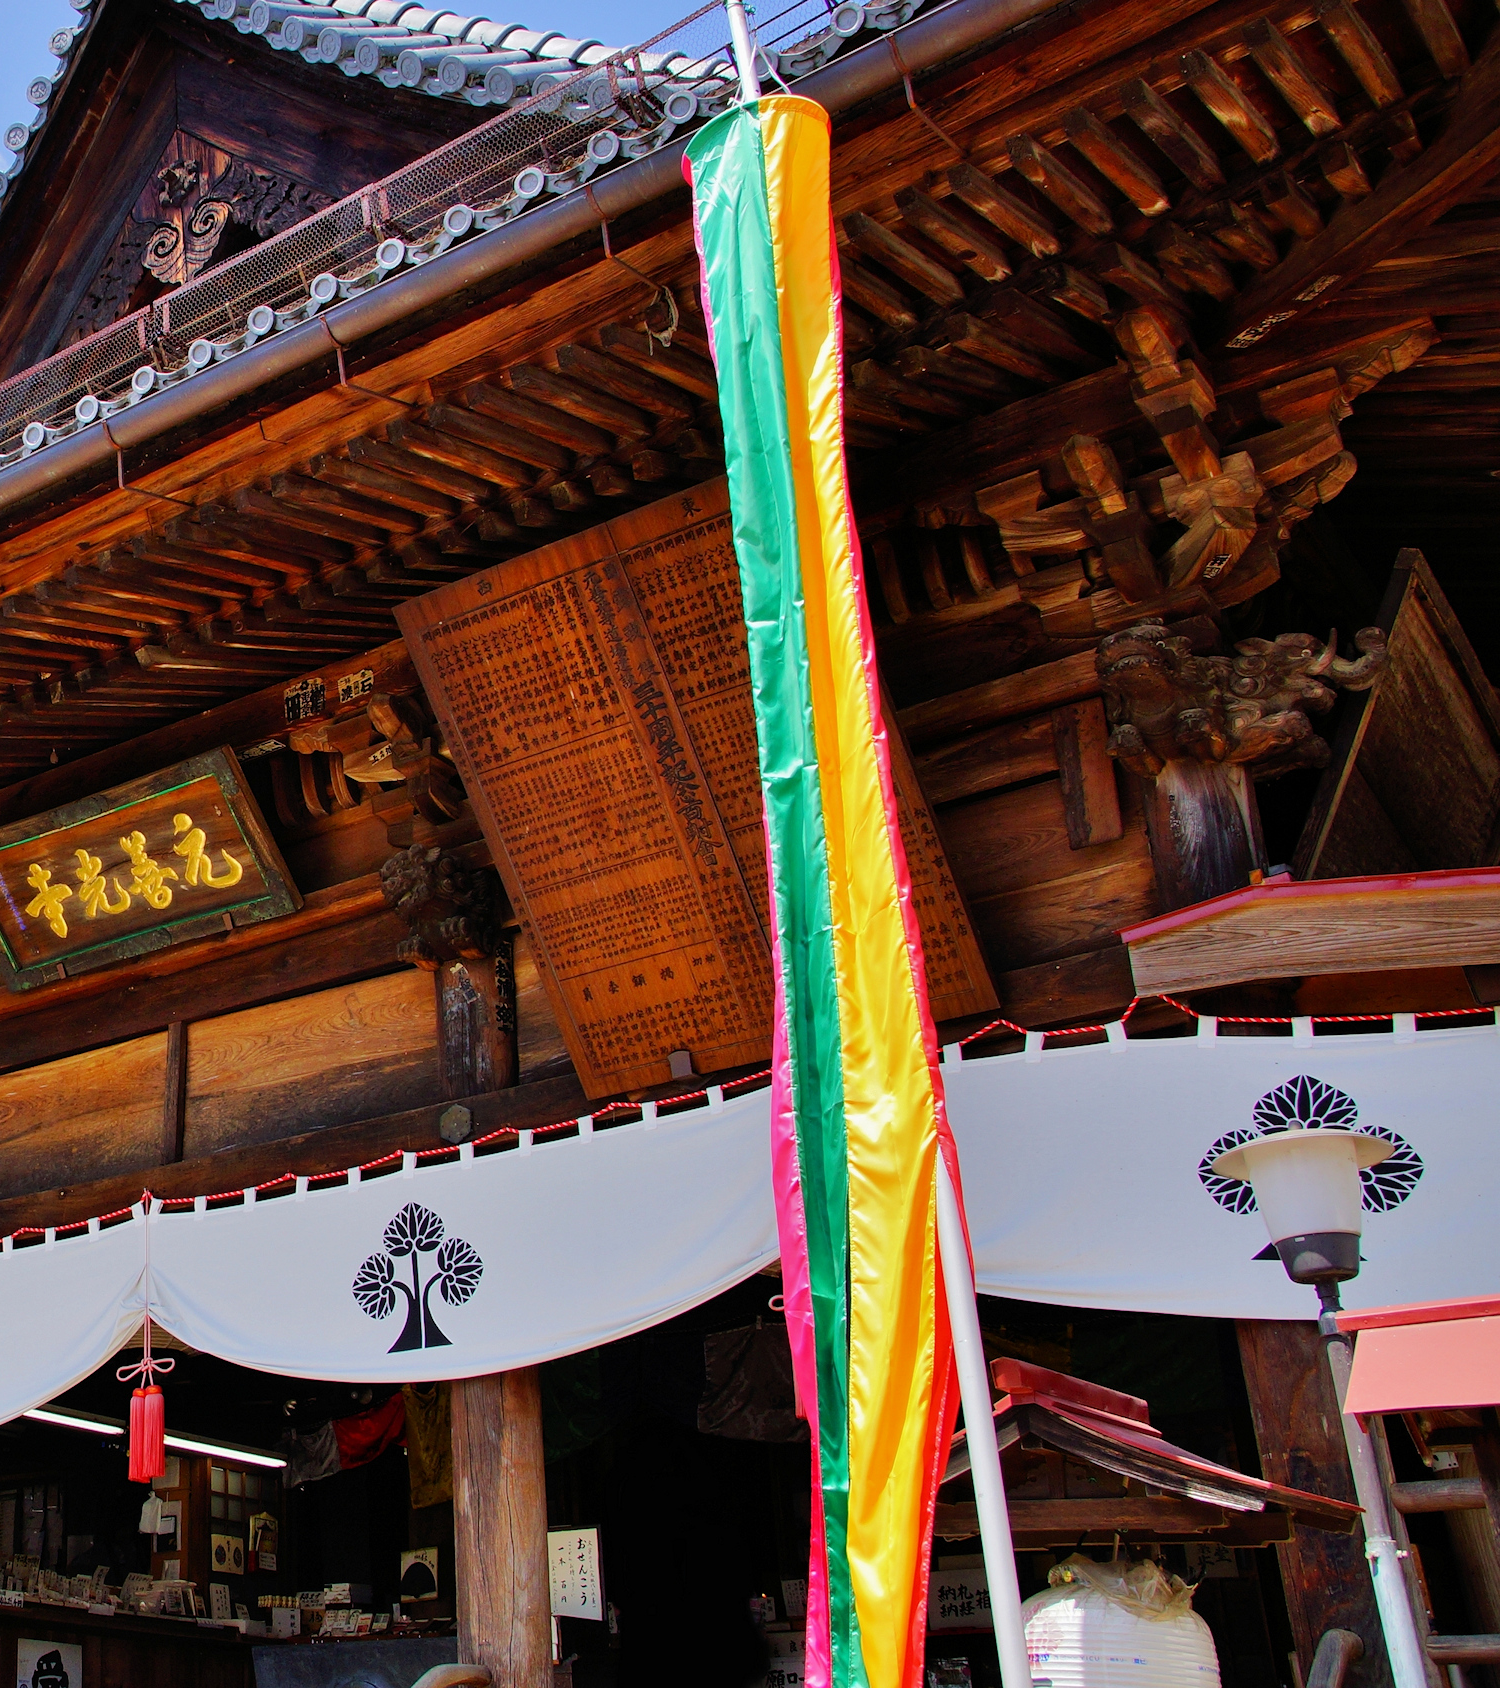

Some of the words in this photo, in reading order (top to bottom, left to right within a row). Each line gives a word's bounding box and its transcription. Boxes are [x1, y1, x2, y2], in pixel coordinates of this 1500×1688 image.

[678, 497, 703, 519] 東
[474, 577, 494, 597] 西
[25, 813, 243, 939] 元善光寺
[577, 1537, 587, 1606] おせんこう
[938, 1584, 974, 1602] 納札
